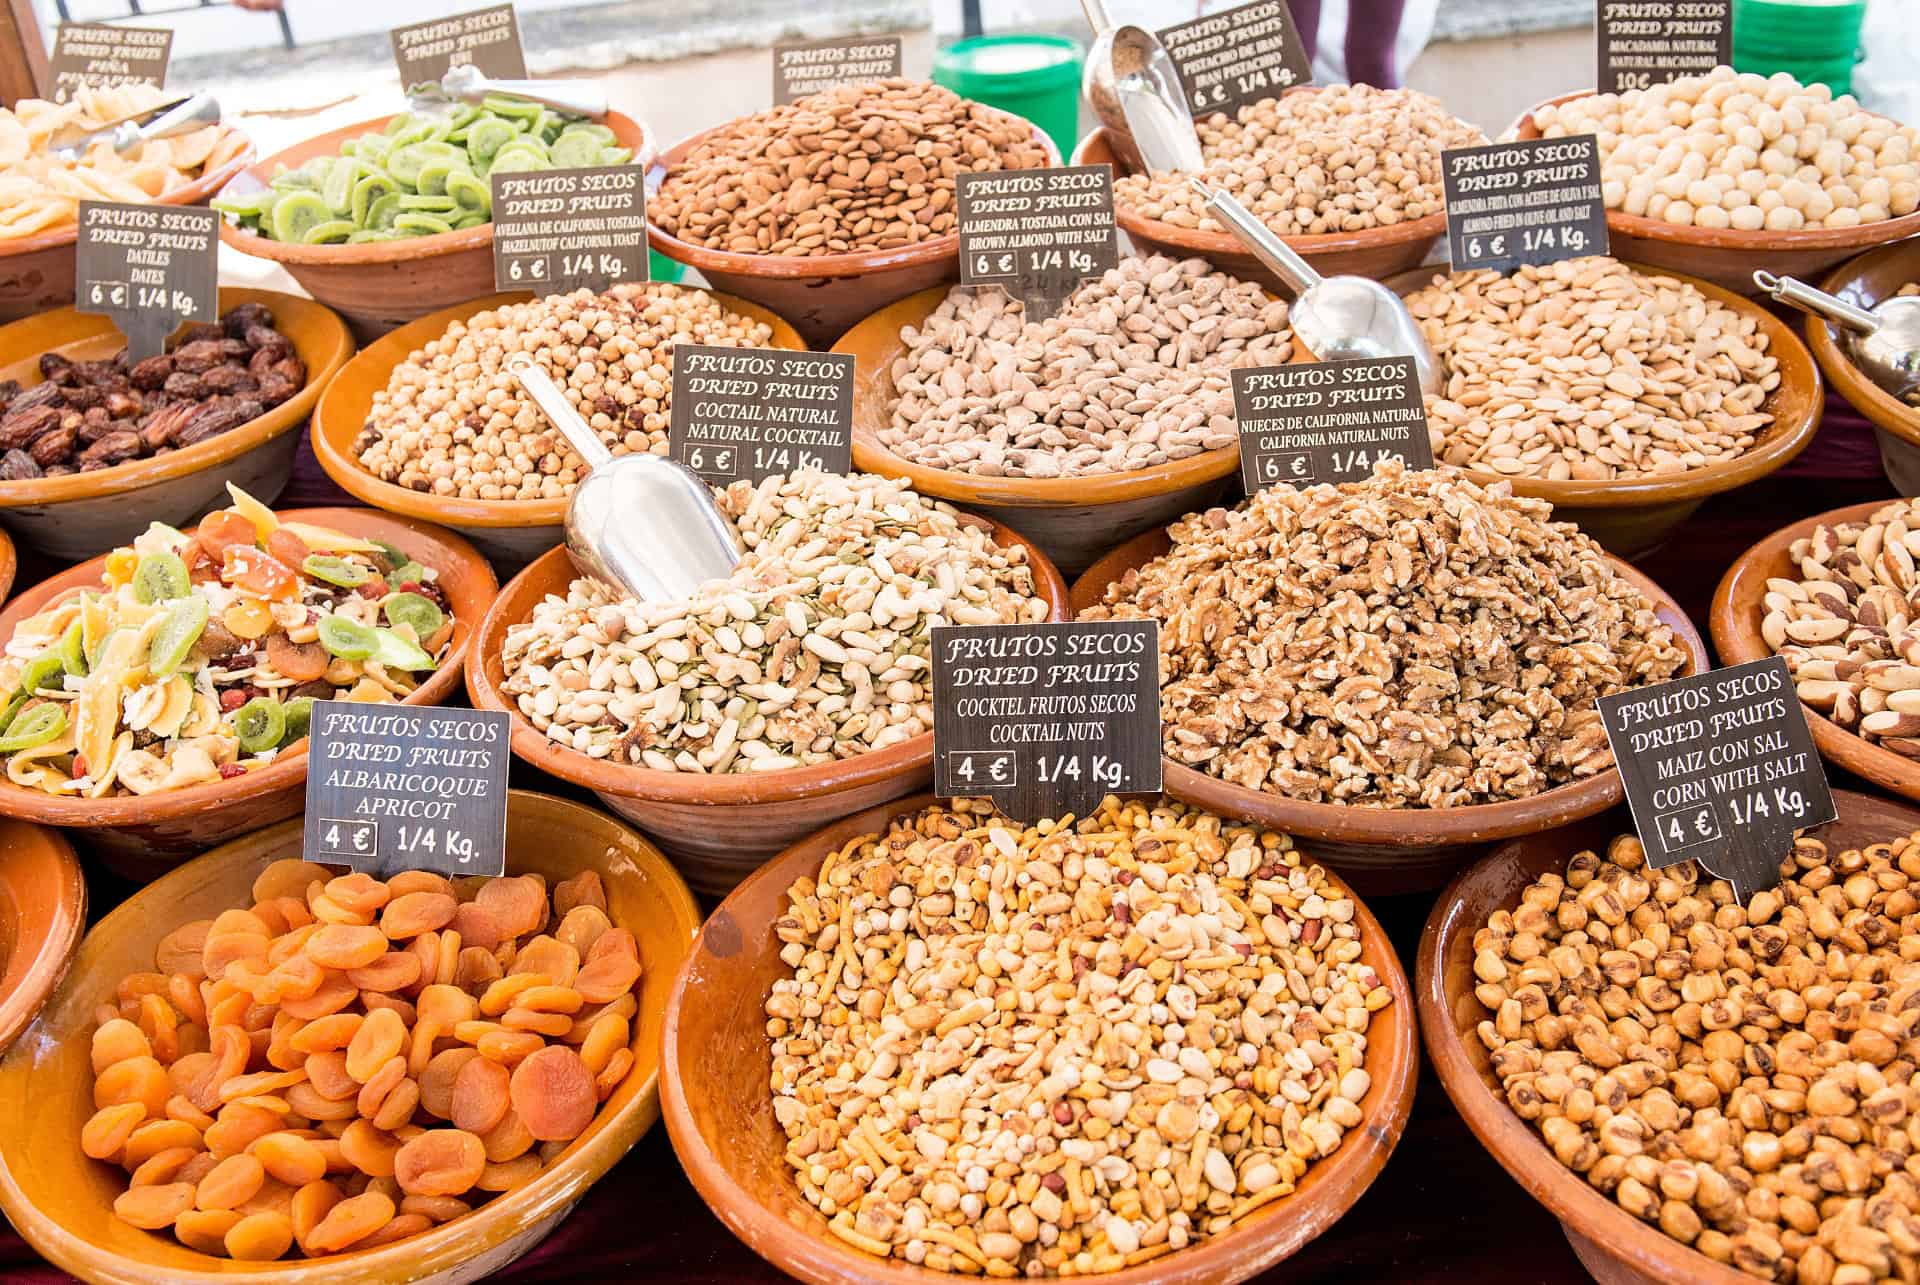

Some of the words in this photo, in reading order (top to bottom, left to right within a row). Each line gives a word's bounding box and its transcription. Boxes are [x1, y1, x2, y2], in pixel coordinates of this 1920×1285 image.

[1603, 2, 1673, 20] FRUTOS
[1675, 3, 1727, 17] SECOS
[399, 21, 462, 49] FRUTOS
[464, 9, 511, 32] SECOS
[1164, 16, 1231, 49] FRUTOS
[1232, 1, 1280, 27] SECOS
[1608, 21, 1661, 34] DRIED
[1662, 21, 1722, 37] FRUITS
[1173, 35, 1225, 60] DRIED
[1226, 17, 1282, 46] FRUITS
[779, 48, 848, 68] FRUTOS
[848, 44, 896, 60] SECOS
[784, 64, 834, 79] DRIED
[836, 61, 892, 77] FRUITS
[1194, 90, 1207, 106] 6
[1212, 84, 1226, 101] €
[1238, 71, 1267, 93] 1/4
[1451, 148, 1529, 176] FRUTOS
[1534, 142, 1591, 163] SECOS
[500, 176, 577, 199] FRUTOS
[581, 173, 636, 190] SECOS
[964, 176, 1043, 198] FRUTOS
[1048, 173, 1104, 190] SECOS
[1457, 172, 1518, 193] DRIED
[1521, 163, 1588, 187] FRUITS
[506, 198, 564, 215] DRIED
[568, 193, 632, 214] FRUITS
[970, 198, 1031, 213] DRIED
[1035, 193, 1102, 212] FRUITS
[85, 208, 158, 228] FRUTOS
[160, 213, 212, 232] SECOS
[496, 221, 538, 236] AVELLANA
[540, 220, 552, 233] DE
[554, 217, 605, 233] CALIFORNIA
[607, 216, 644, 229] TOSTADA
[962, 218, 1018, 233] ALMENDRA
[1021, 215, 1067, 230] TOSTADA
[1069, 213, 1091, 226] CON
[1094, 212, 1113, 224] SAL
[90, 228, 145, 245] DRIED
[146, 232, 208, 250] FRUITS
[560, 235, 611, 249] CALIFORNIA
[613, 233, 640, 246] TOAST
[969, 236, 1007, 250] BROWN
[1008, 232, 1053, 248] ALMOND
[1055, 231, 1082, 244] WITH
[1084, 229, 1110, 242] SALT
[1469, 238, 1481, 258] 6
[1490, 236, 1504, 254] €
[1523, 228, 1555, 250] 1/4
[1561, 226, 1589, 250] Kg.
[127, 248, 170, 266] DATILES
[510, 260, 522, 280] 6
[531, 260, 544, 278] €
[563, 255, 593, 275] 1/4
[600, 254, 627, 278] Kg.
[977, 255, 989, 273] 6
[998, 254, 1013, 271] €
[1031, 251, 1062, 270] 1/4
[1069, 250, 1098, 272] Kg.
[131, 268, 165, 284] DATES
[91, 285, 103, 304] 6
[111, 286, 124, 304] €
[138, 288, 167, 308] 1/4
[172, 290, 198, 316] Kg.
[683, 355, 776, 375] FRUTOS
[780, 360, 846, 379] SECOS
[1243, 369, 1335, 393] FRUTOS
[1342, 364, 1407, 383] SECOS
[689, 378, 758, 396] DRIED
[762, 383, 839, 401] FRUITS
[1251, 392, 1322, 410] DRIED
[1328, 385, 1406, 407] FRUITS
[695, 402, 763, 421] COCTAIL
[767, 407, 839, 424] NATURAL
[1241, 418, 1285, 433] NUECES
[1287, 416, 1303, 430] DE
[1305, 412, 1370, 429] CALIFORNIA
[1373, 408, 1424, 422] NATURAL
[687, 424, 760, 442] NATURAL
[764, 428, 844, 446] COCKTAIL
[1260, 434, 1326, 450] CALIFORNIA
[1327, 430, 1379, 445] NATURAL
[1381, 427, 1409, 440] NUTS
[690, 448, 702, 469] 6
[716, 451, 731, 470] €
[755, 448, 790, 470] 1/4
[1266, 458, 1279, 477] 6
[1291, 457, 1306, 475] €
[1332, 450, 1369, 473] 1/4
[944, 634, 1057, 663] FRUTOS
[1065, 632, 1146, 655] SECOS
[952, 666, 1038, 687] DRIED
[1045, 660, 1140, 687] FRUITS
[957, 696, 1025, 717] COCKTEL
[1028, 695, 1086, 714] FRUTOS
[1090, 694, 1136, 713] SECOS
[1617, 687, 1711, 732] FRUTOS
[1716, 669, 1782, 703] SECOS
[321, 713, 421, 737] FRUTOS
[427, 720, 498, 742] SECOS
[990, 723, 1064, 742] COCKTAIL
[1066, 722, 1105, 740] NUTS
[1631, 719, 1704, 753] DRIED
[1710, 698, 1786, 738] FRUITS
[328, 742, 401, 761] DRIED
[406, 747, 491, 768] FRUITS
[1657, 751, 1707, 780] MAIZ
[1709, 739, 1749, 766] CON
[1754, 731, 1789, 755] SAL
[325, 769, 489, 798] ALBARICOQUE
[958, 757, 974, 782] 4
[989, 757, 1008, 781] €
[1037, 755, 1081, 782] 1/4
[1092, 755, 1131, 788] Kg.
[1653, 780, 1707, 810] CORN
[1710, 766, 1760, 793] WITH
[1765, 753, 1808, 781] SALT
[356, 797, 456, 819] APRICOT
[1669, 818, 1684, 843] 4
[1695, 810, 1712, 836] €
[1730, 791, 1769, 825] 1/4
[1774, 787, 1811, 818] Kg.
[325, 825, 340, 848] 4
[353, 827, 370, 850] €
[398, 826, 436, 852] 1/4
[446, 830, 480, 863] Kg.
